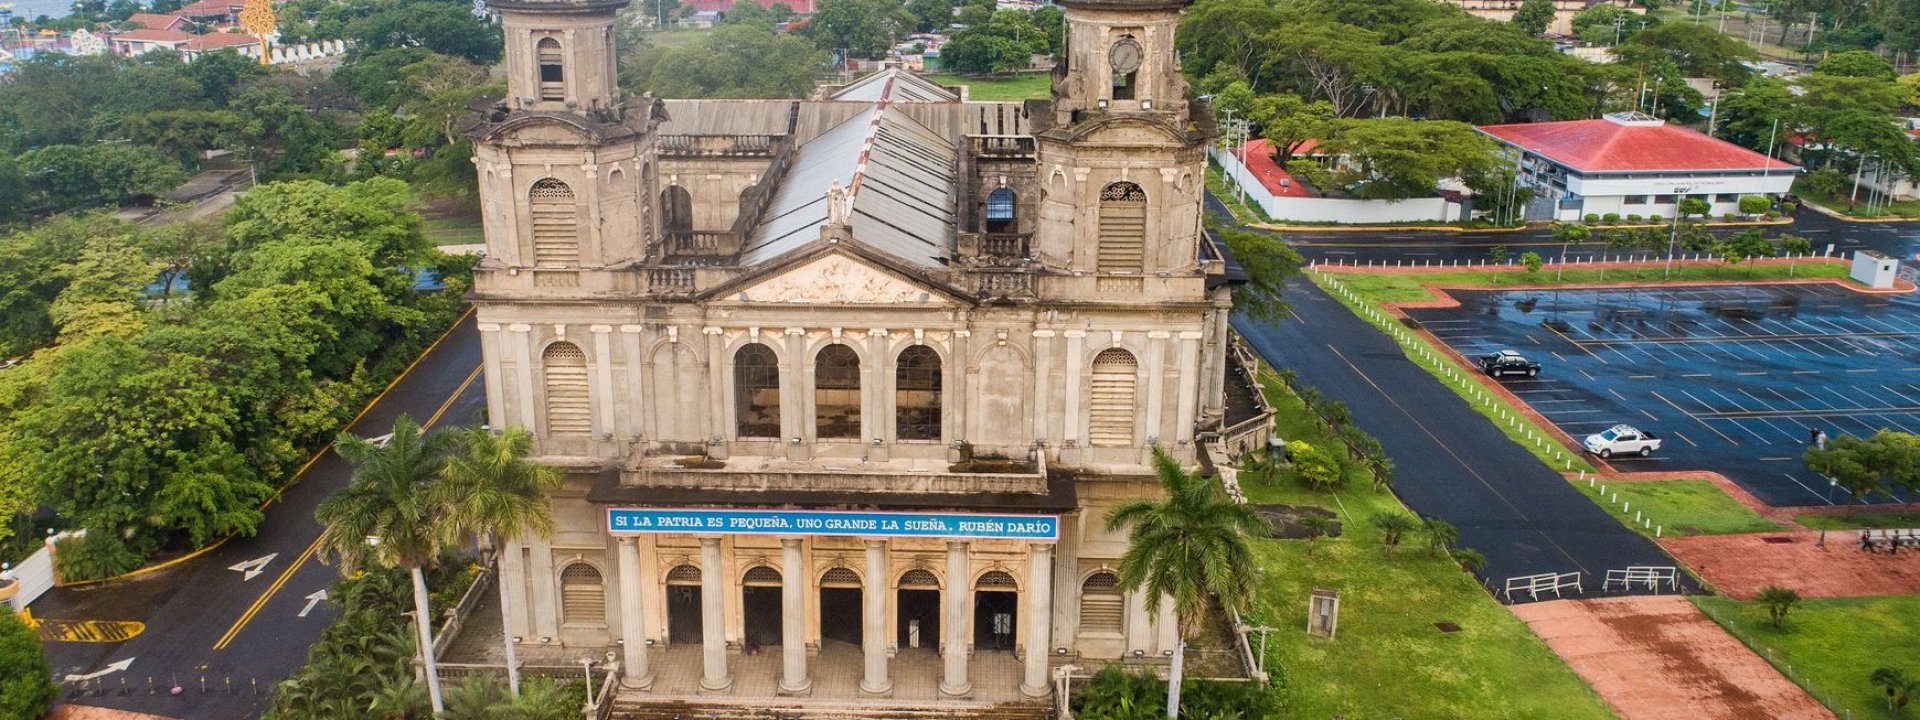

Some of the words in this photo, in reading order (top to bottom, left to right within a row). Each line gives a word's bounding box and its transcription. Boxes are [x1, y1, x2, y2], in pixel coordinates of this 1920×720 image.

[615, 516, 628, 526] SI
[633, 516, 652, 526] LA
[657, 516, 704, 527] PATRIA
[707, 517, 724, 527] ES
[729, 516, 793, 529] PEQUEÑA,
[796, 518, 823, 529] UNO
[825, 518, 877, 530] GRANDE
[881, 520, 900, 530] LA
[959, 519, 1004, 532] RUBÉN
[1007, 520, 1051, 533] DARÍO
